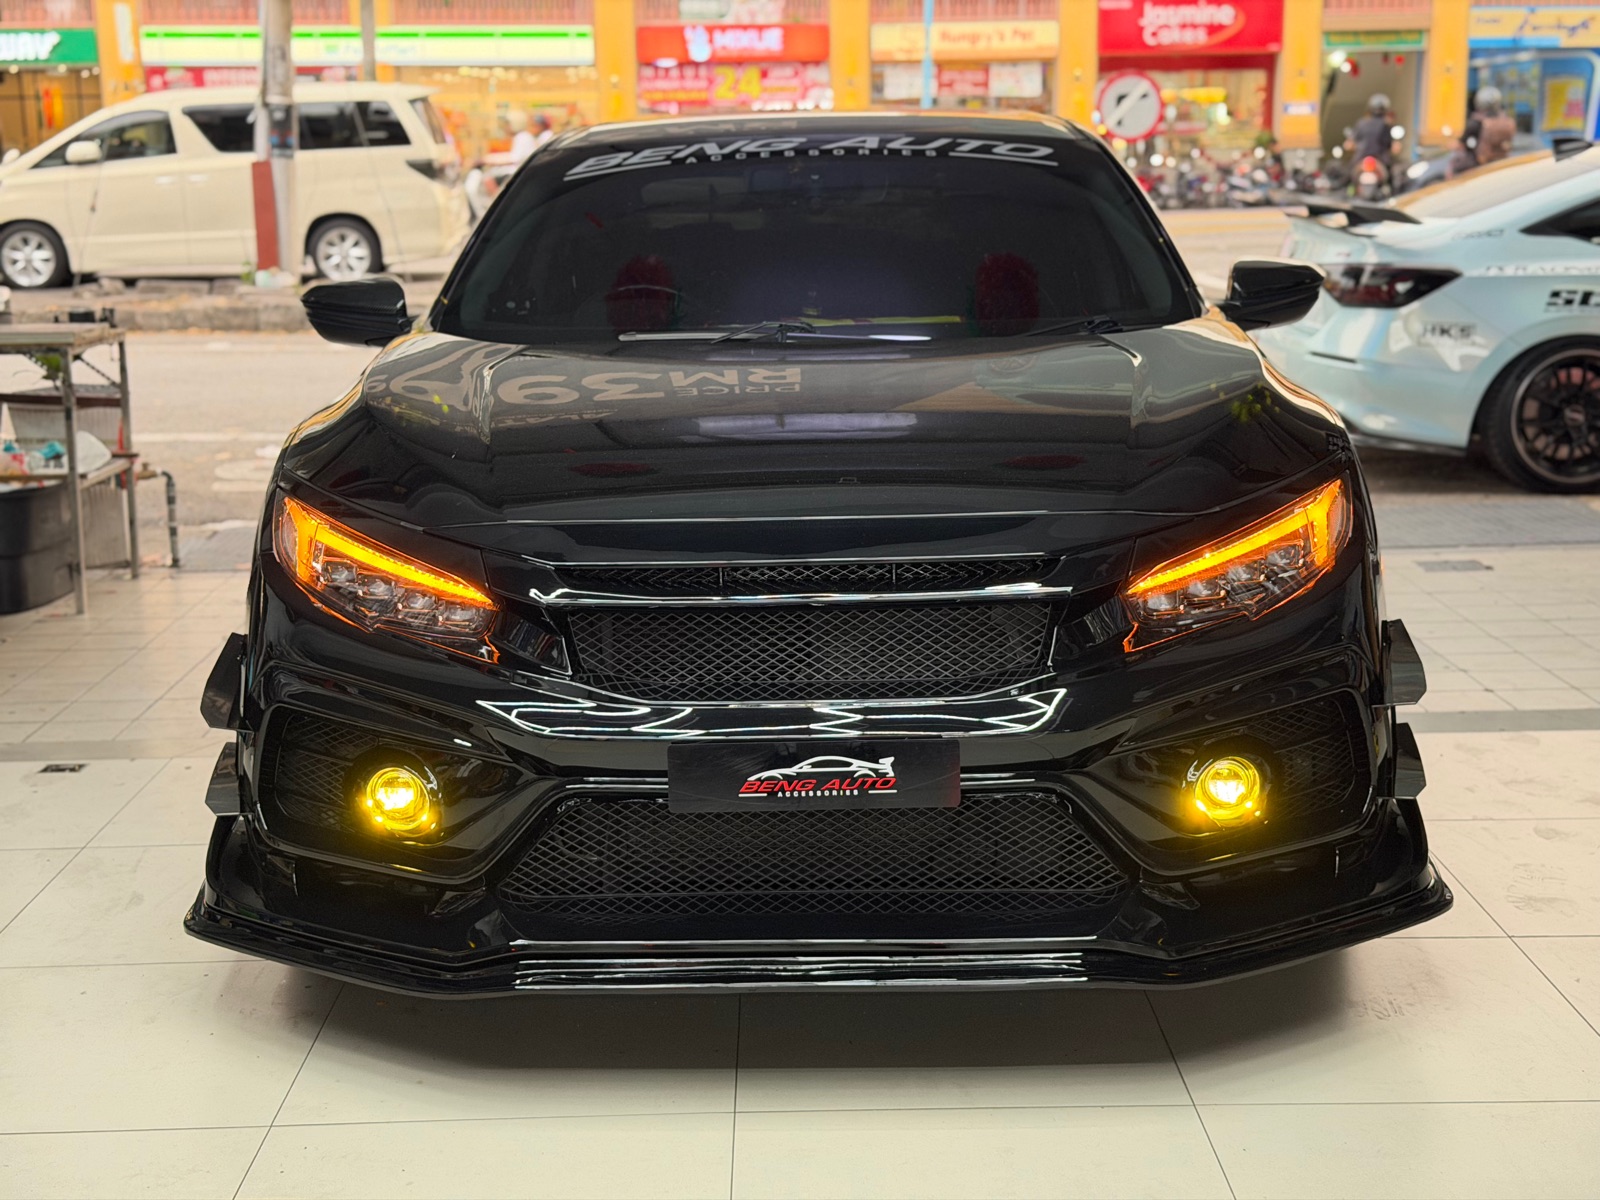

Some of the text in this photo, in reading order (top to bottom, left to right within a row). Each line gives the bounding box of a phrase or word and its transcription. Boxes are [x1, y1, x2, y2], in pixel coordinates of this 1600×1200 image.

[1138, 1, 1236, 27] Jasmine
[1142, 26, 1208, 46] Cakes
[714, 64, 762, 100] 24
[565, 136, 1054, 176] BENG AUTO
[685, 148, 937, 165] ACCESSORIES
[739, 777, 897, 793] BENG AUTO
[777, 789, 859, 798] ACCESSORIES
